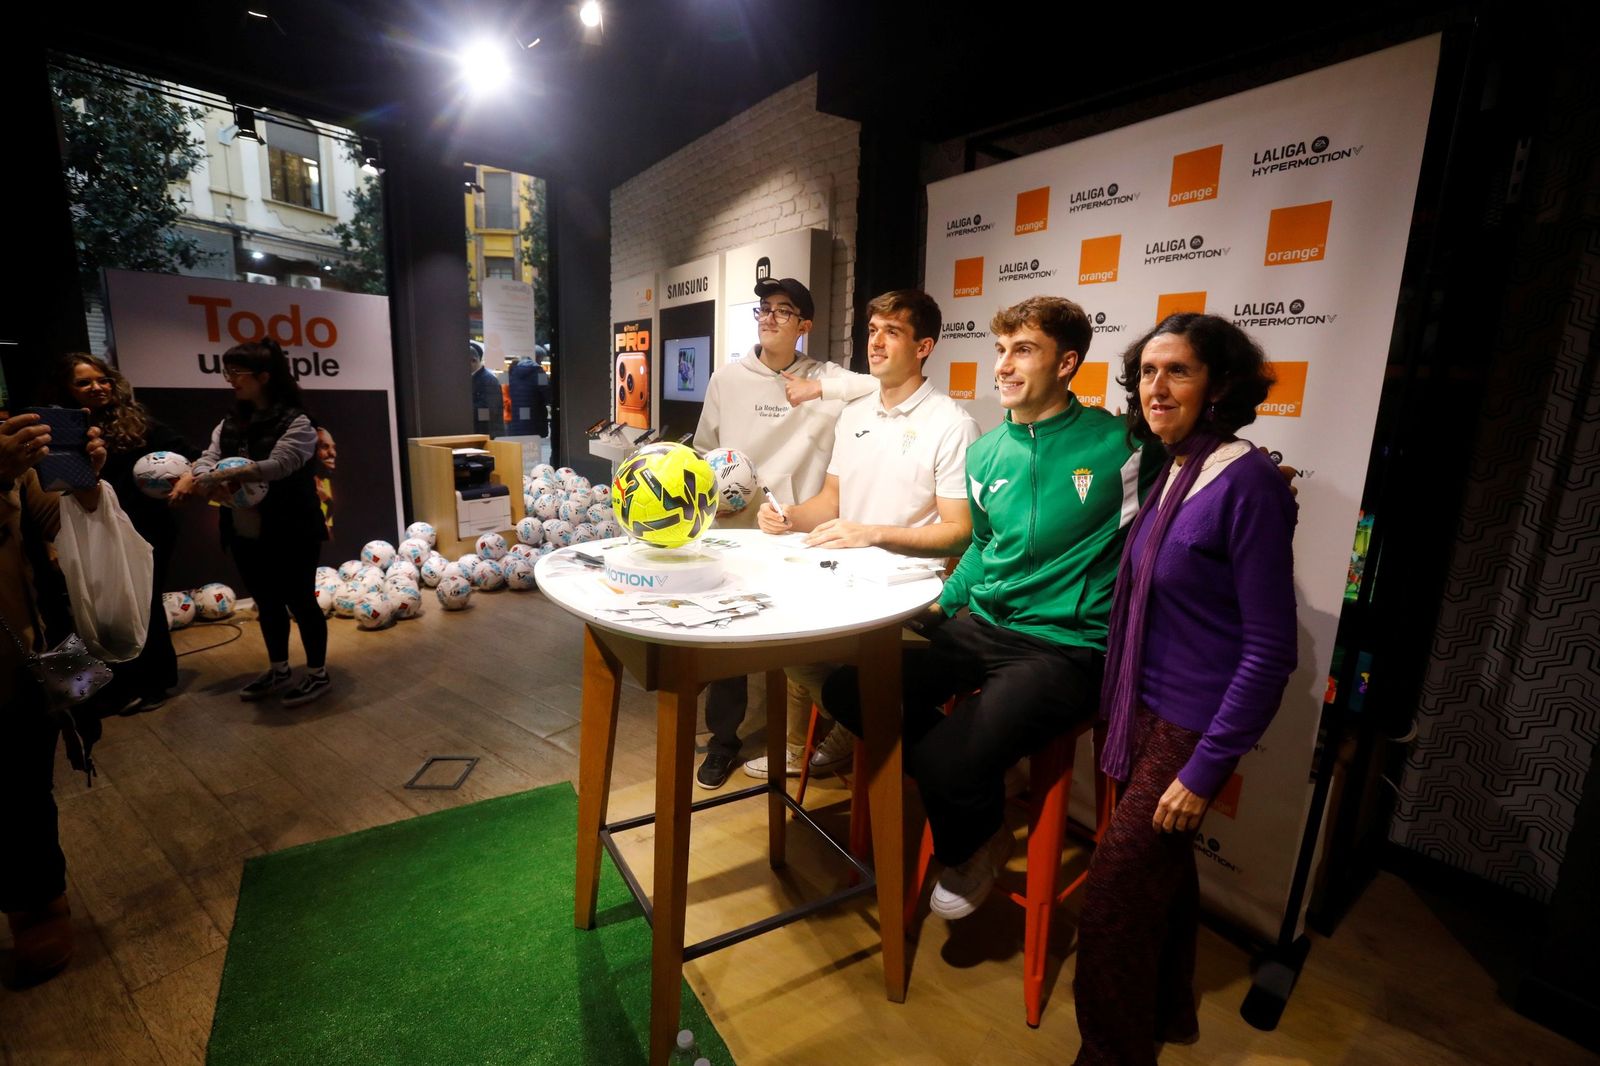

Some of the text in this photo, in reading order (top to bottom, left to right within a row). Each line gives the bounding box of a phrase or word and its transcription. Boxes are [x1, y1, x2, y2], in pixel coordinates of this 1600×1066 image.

[1253, 142, 1307, 165] LALIGA
[1070, 187, 1105, 204] LALIGA
[1171, 186, 1213, 203] orange
[947, 217, 972, 230] LALIGA
[1016, 220, 1045, 233] orange
[1145, 238, 1186, 255] LALIGA
[1268, 247, 1319, 262] orange
[999, 261, 1029, 274] LALIGA
[1080, 270, 1114, 282] orange
[667, 276, 709, 300] SAMSUNG
[954, 286, 980, 296] orange
[1234, 301, 1285, 317] LALIGA
[188, 295, 338, 349] Todo
[942, 321, 965, 332] LALIGA
[615, 330, 650, 352] PRO
[1256, 402, 1296, 415] range
